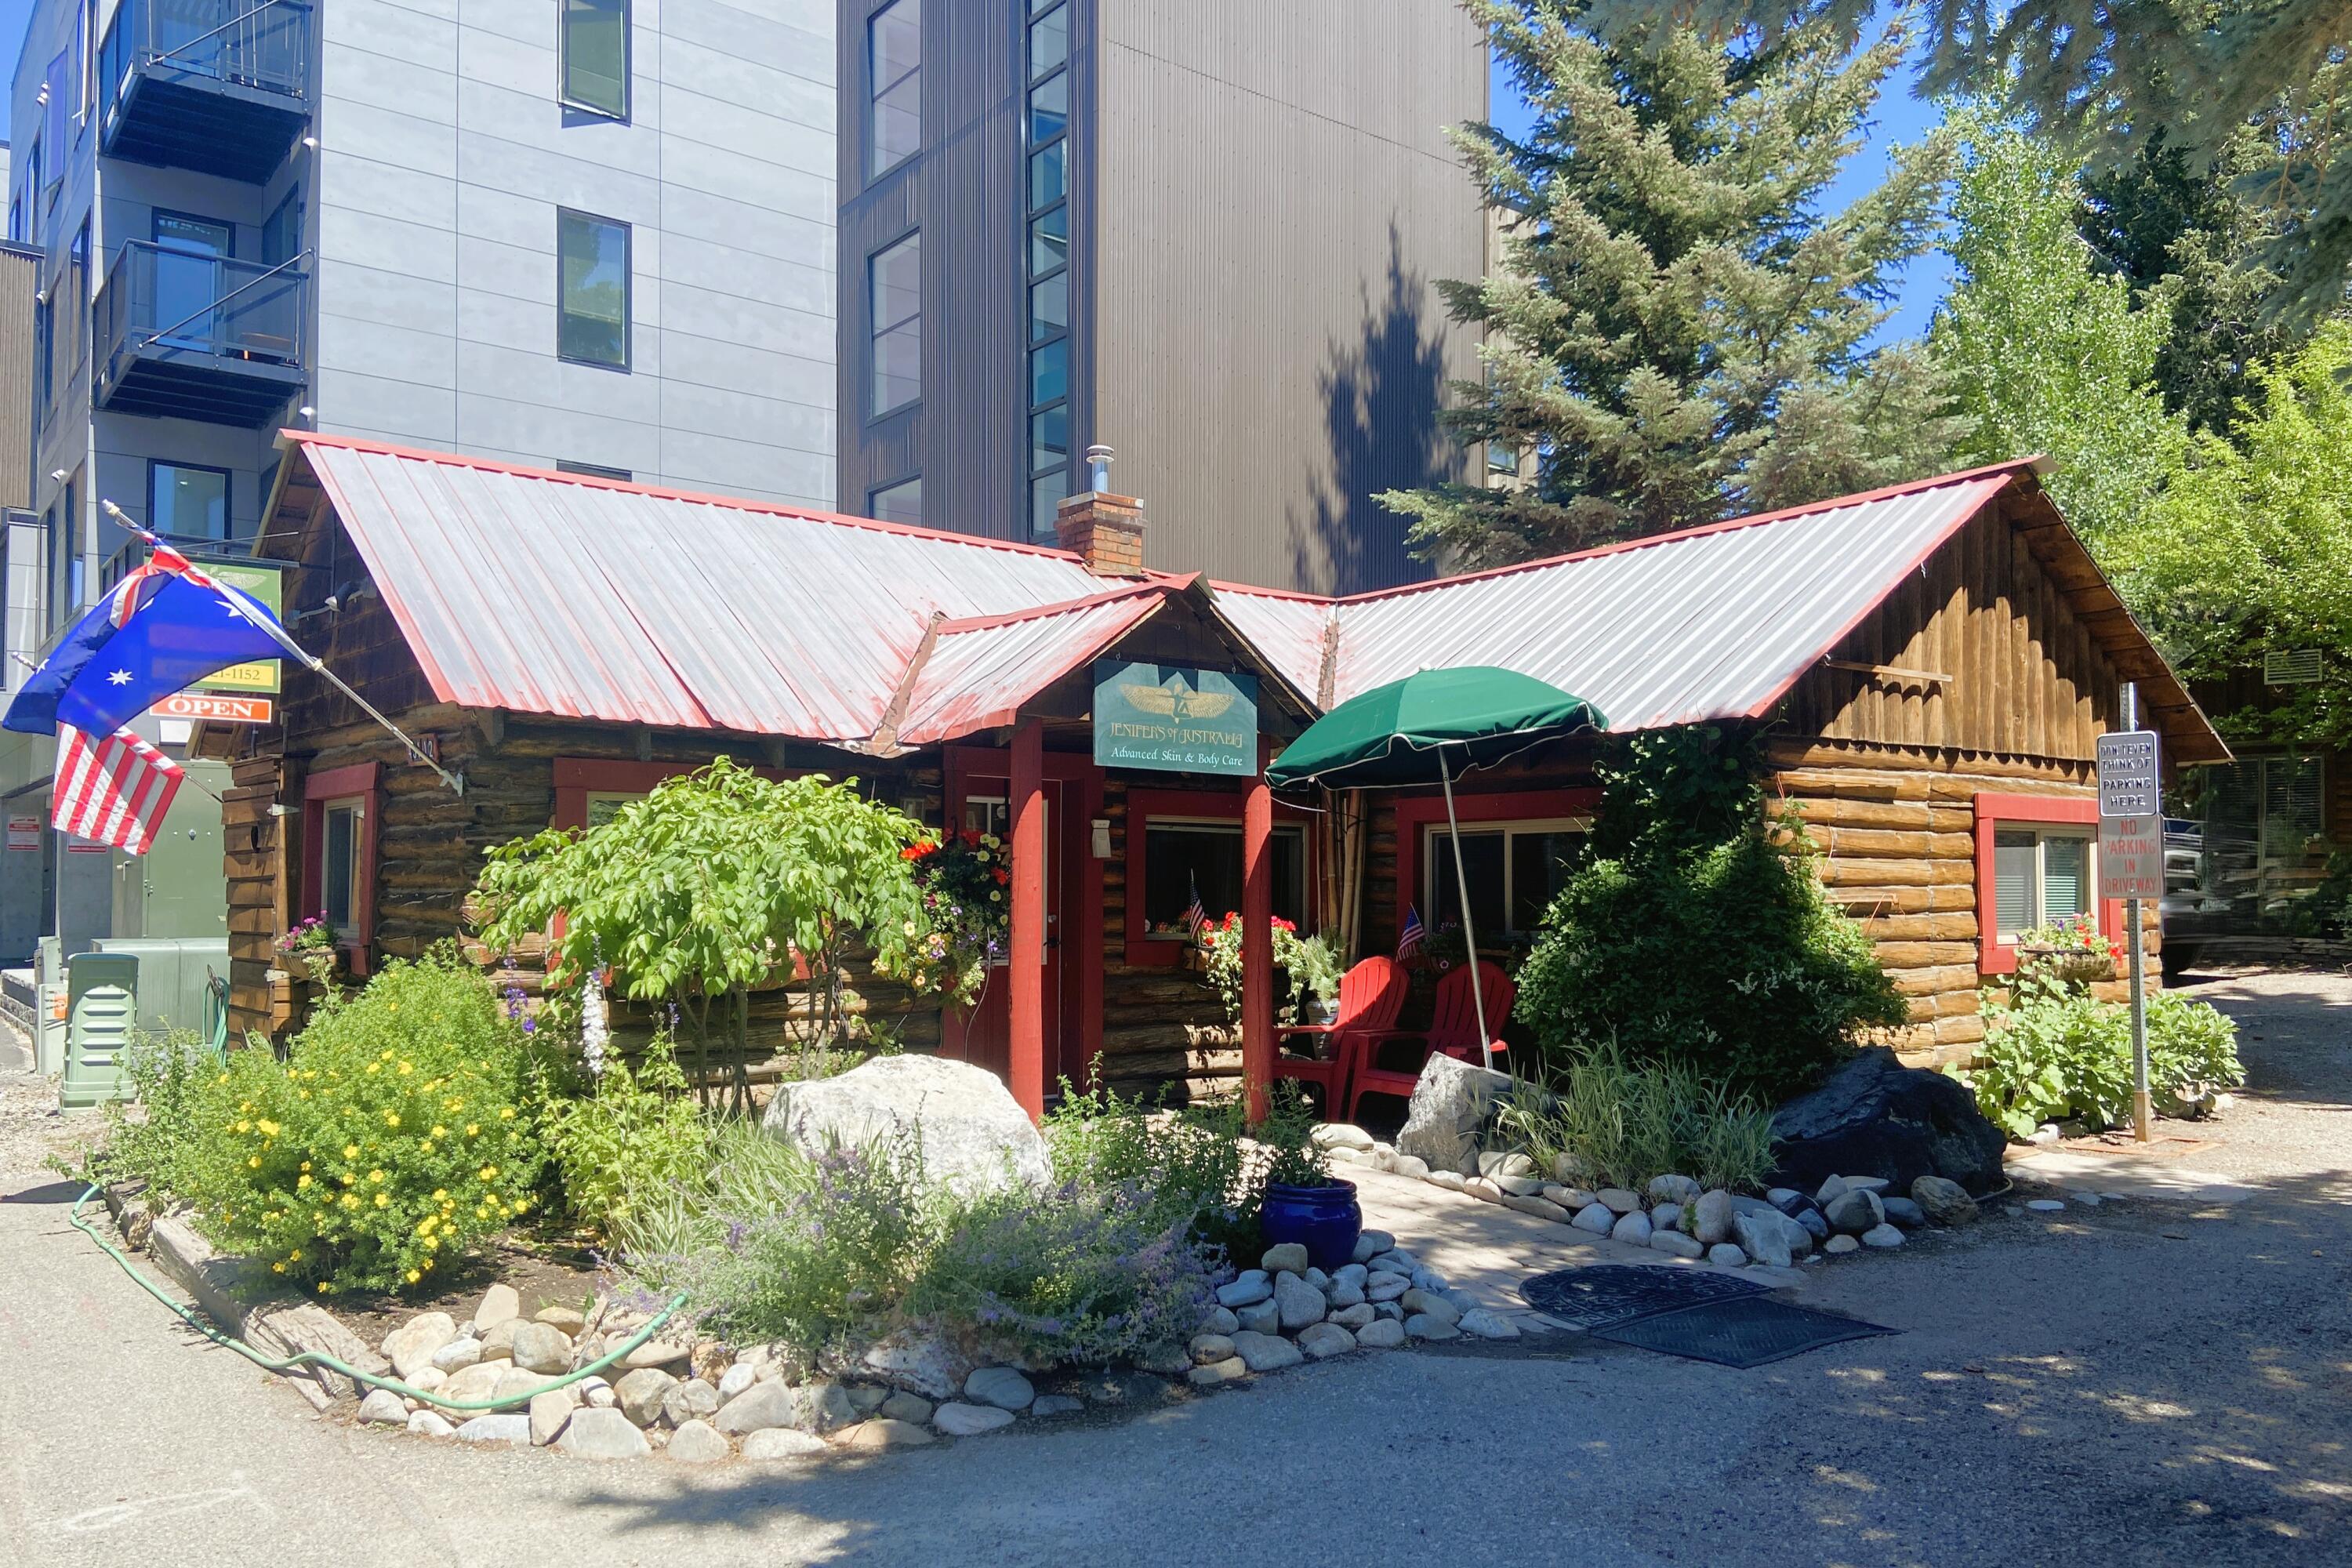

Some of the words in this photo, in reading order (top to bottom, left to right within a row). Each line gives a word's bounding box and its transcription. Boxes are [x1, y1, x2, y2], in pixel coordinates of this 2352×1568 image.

[210, 668, 260, 681] 1-1152
[168, 698, 255, 717] OPEN
[1110, 722, 1166, 742] JENIFER'S
[1178, 728, 1243, 749] AUSTRALIA
[2127, 742, 2151, 755] EVEN
[1110, 746, 1159, 760] Advanced
[1161, 749, 1181, 761] Skin
[1185, 753, 1195, 763] &
[1198, 753, 1220, 768] Body
[1222, 755, 1243, 766] Care
[2102, 757, 2135, 770] THINK
[2137, 757, 2151, 769] OF
[2103, 776, 2151, 790] PARKING
[2111, 793, 2146, 807] HERE
[2121, 819, 2137, 835] NO
[2104, 838, 2156, 855] PARKING
[2125, 858, 2136, 873] IN
[2105, 877, 2156, 893] DRIVEWAY
